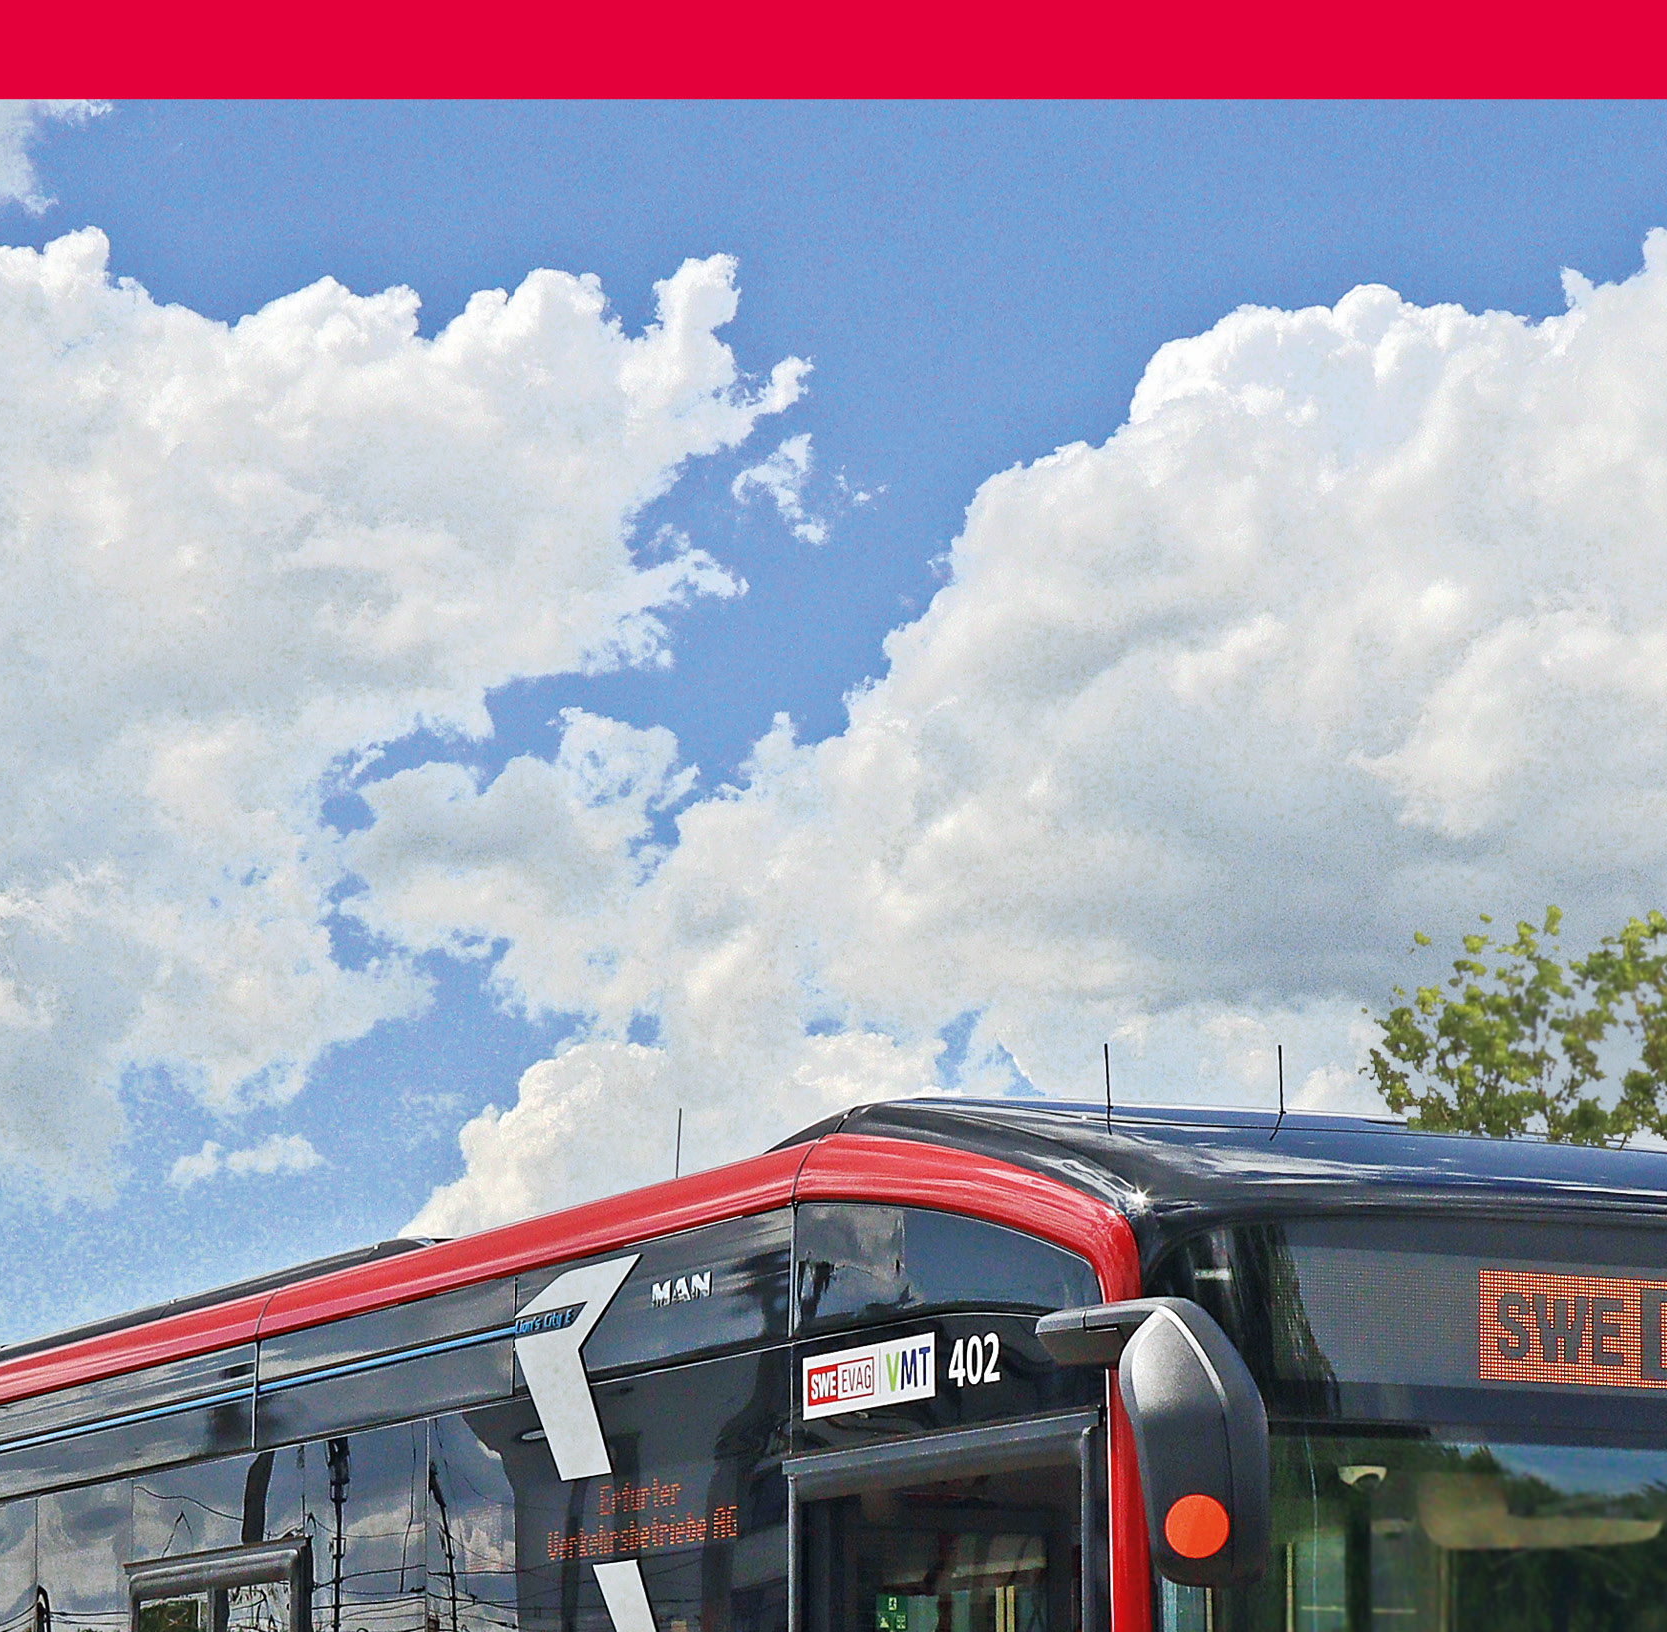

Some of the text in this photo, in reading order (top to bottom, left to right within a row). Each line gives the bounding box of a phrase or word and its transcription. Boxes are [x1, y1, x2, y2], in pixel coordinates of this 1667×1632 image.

[651, 1271, 713, 1307] MAN
[544, 1312, 563, 1329] City
[565, 1308, 574, 1324] E
[1496, 1293, 1625, 1366] SWE
[885, 1346, 931, 1393] VMT
[948, 1332, 1001, 1388] 402
[810, 1364, 872, 1401] SWE EVAG
[599, 1478, 682, 1515] Erfurter
[547, 1505, 738, 1561] Verkehrsbetriebe AG
